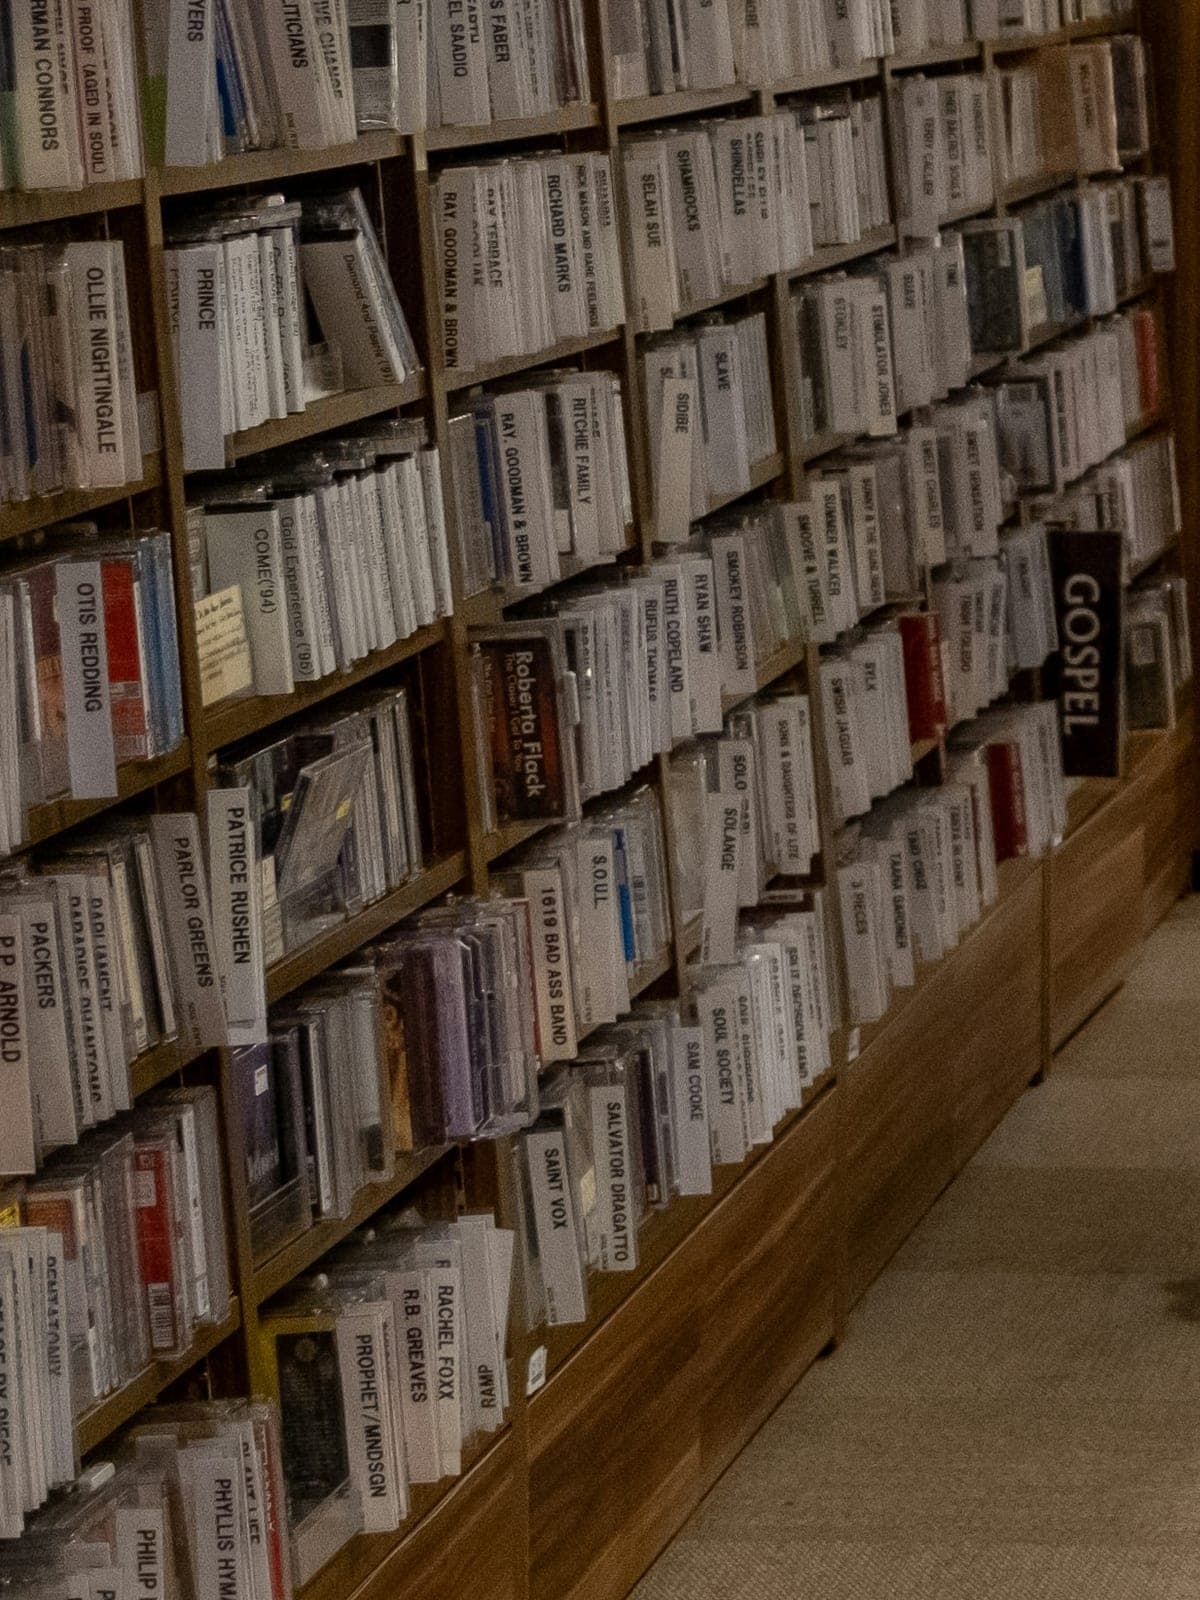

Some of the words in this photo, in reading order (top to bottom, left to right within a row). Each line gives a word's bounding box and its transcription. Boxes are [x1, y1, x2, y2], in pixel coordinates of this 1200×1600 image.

[78, 7, 95, 54] PROOF
[450, 24, 468, 78] SAADIQ
[491, 15, 510, 63] FABER
[35, 58, 59, 151] CONNORS
[82, 63, 99, 107] (AGED
[87, 112, 101, 126] IN
[89, 131, 107, 175] SOUL)
[730, 138, 746, 216] SHINDELLAS
[547, 174, 566, 238] RICHARD
[642, 173, 659, 218] SELAH
[677, 149, 700, 232] SHAMROCKS
[646, 222, 661, 249] SUE
[343, 254, 363, 299] Diamond
[443, 228, 458, 299] GOODMAN
[553, 242, 571, 293] MARKS
[86, 267, 108, 321] OLLIE
[198, 268, 216, 331] PRINCE
[444, 303, 458, 313] &
[444, 320, 459, 368] BROWN
[90, 328, 117, 454] NIGHTINGALE
[714, 351, 730, 391] SLAVE
[878, 380, 892, 416] JONES
[572, 397, 588, 450] RITCHIE
[507, 447, 526, 515] GOODMAN
[575, 455, 592, 505] FAMILY
[281, 516, 299, 553] Gold
[511, 519, 528, 530] &
[823, 493, 838, 544] SUMMER
[254, 528, 278, 615] COME('94)
[514, 534, 534, 584] BROWN
[726, 551, 742, 601] SMOKEY
[826, 549, 841, 596] WALKER
[77, 582, 99, 625] OTIS
[283, 556, 304, 638] Experience
[664, 579, 680, 615] RUTH
[694, 573, 709, 610] RYAN
[666, 619, 683, 692] COPELAND
[696, 615, 712, 653] SHAW
[730, 605, 748, 670] ROBINSON
[1062, 573, 1101, 736] GOSPEL
[81, 632, 103, 713] REDDING
[515, 651, 538, 735] Roberta
[523, 741, 547, 798] Flack
[733, 754, 747, 791] SOLO
[227, 807, 249, 885] PATRICE
[721, 807, 738, 871] SOLANGE
[174, 837, 199, 909] PARLOR
[187, 916, 213, 988] GREENS
[230, 891, 252, 965] RUSHEN
[541, 886, 558, 927] 1619
[31, 922, 56, 1009] PACKERS
[545, 933, 561, 963] BAD
[546, 969, 563, 998] ASS
[0, 981, 21, 1063] ARNOLD
[549, 1004, 567, 1046] BAND
[712, 1007, 728, 1043] SOUL
[687, 1041, 701, 1070] SAM
[718, 1048, 735, 1105] SOCIETY
[689, 1074, 704, 1120] COOKE
[606, 1101, 625, 1177] SALVATOR
[545, 1148, 562, 1191] SAINT
[551, 1197, 568, 1230] VOX
[612, 1183, 630, 1261] DRAGATTO
[403, 1289, 422, 1320] R.B.
[438, 1285, 455, 1350] RACHEL
[406, 1327, 428, 1403] GREAVES
[439, 1357, 455, 1400] FOXX
[477, 1364, 497, 1408] RAMP
[355, 1334, 387, 1498] PROPHET/MNDSGN
[214, 1478, 235, 1552] PHYLLIS
[136, 1529, 157, 1590] PHILIP
